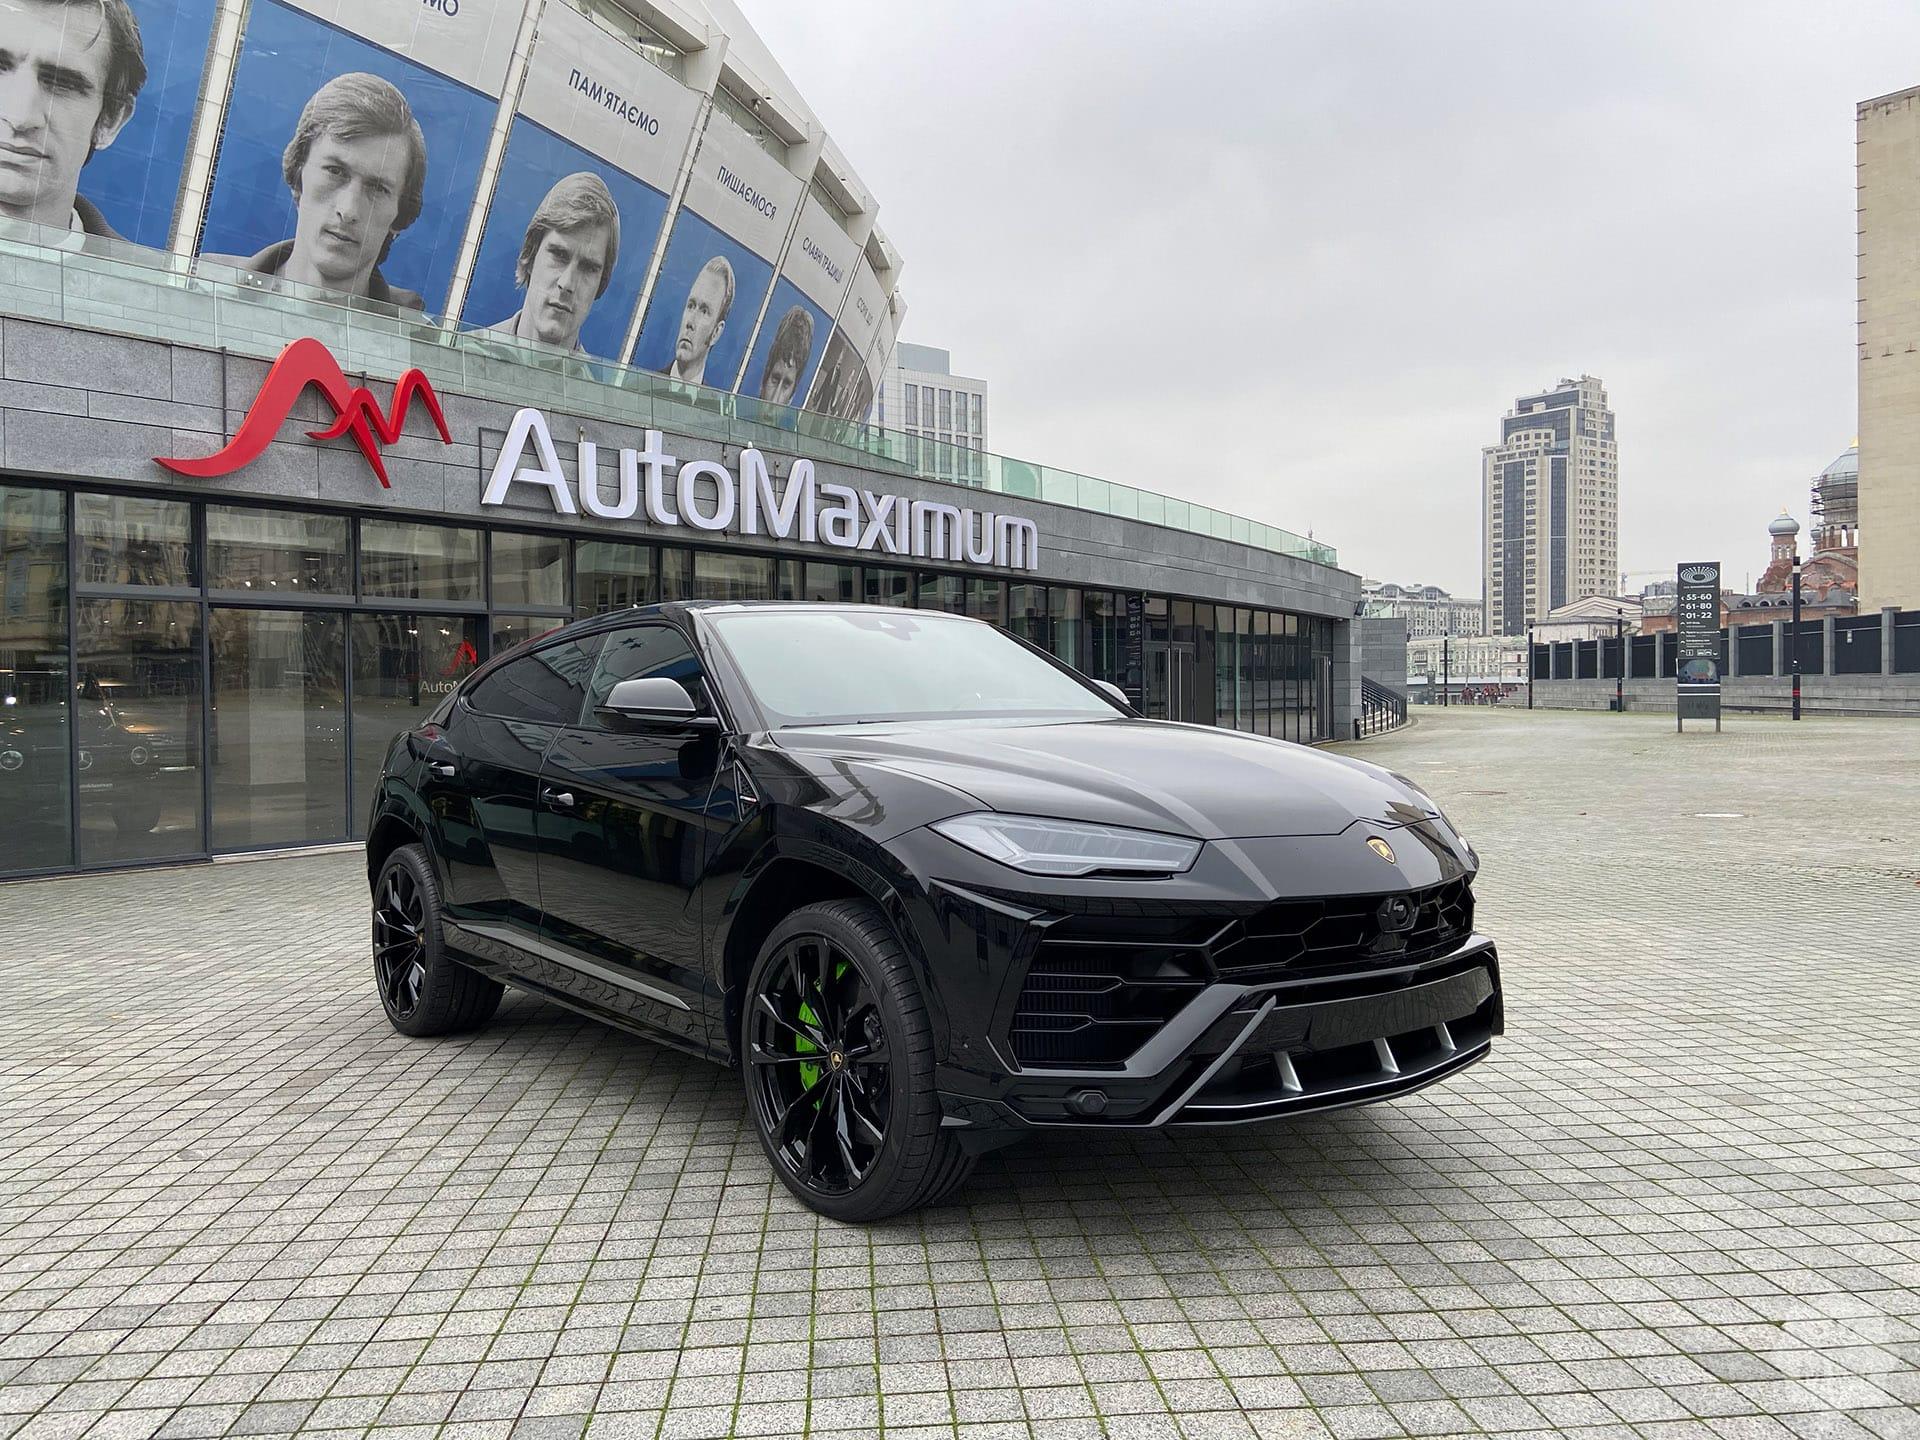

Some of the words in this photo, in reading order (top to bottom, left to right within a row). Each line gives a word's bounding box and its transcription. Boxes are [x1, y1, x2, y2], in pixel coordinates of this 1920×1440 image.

[568, 68, 659, 136] ПАМ'ЯТАЄМО
[717, 165, 777, 221] ПИШАЄМОСЯ
[481, 407, 1039, 571] AutoMaximum
[1685, 602, 1712, 610] 61-80
[1686, 593, 1712, 601] 55-60
